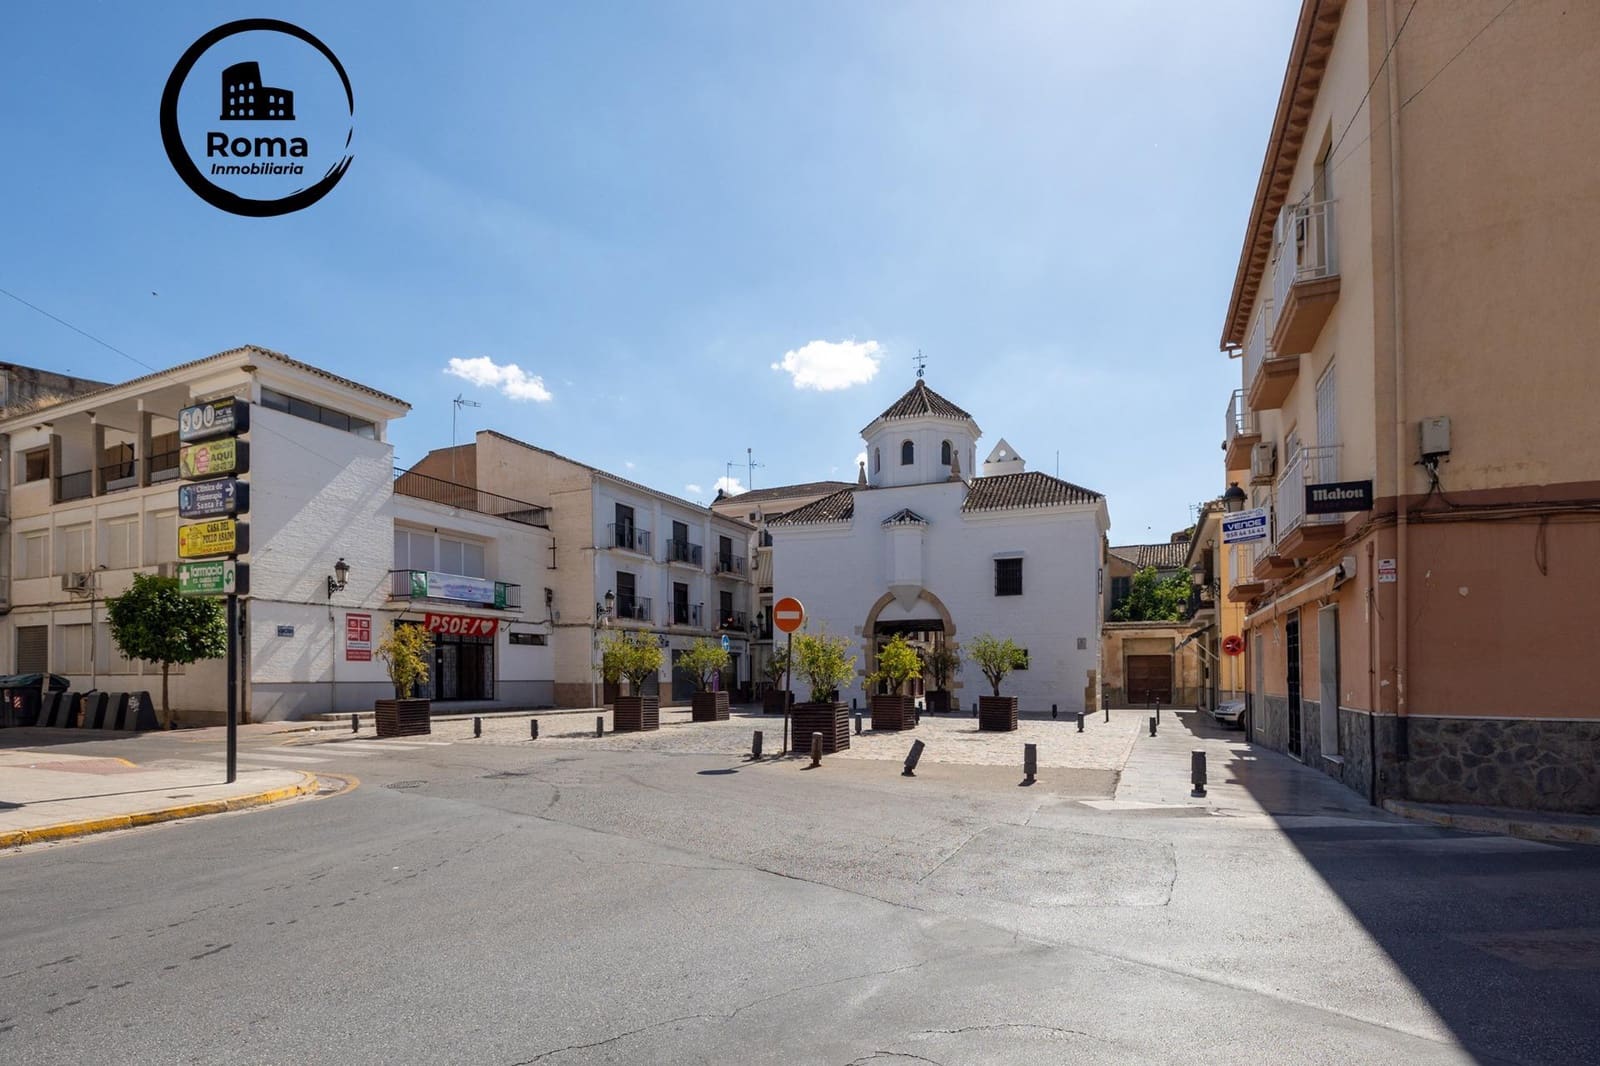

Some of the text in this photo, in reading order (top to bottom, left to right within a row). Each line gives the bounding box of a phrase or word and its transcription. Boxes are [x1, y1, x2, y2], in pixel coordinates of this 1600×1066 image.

[1312, 488, 1364, 501] Mahou
[196, 501, 215, 510] Santa
[207, 521, 229, 533] CASA DEL
[1227, 519, 1262, 530] VENDE
[202, 531, 234, 544] POLLO ASADO
